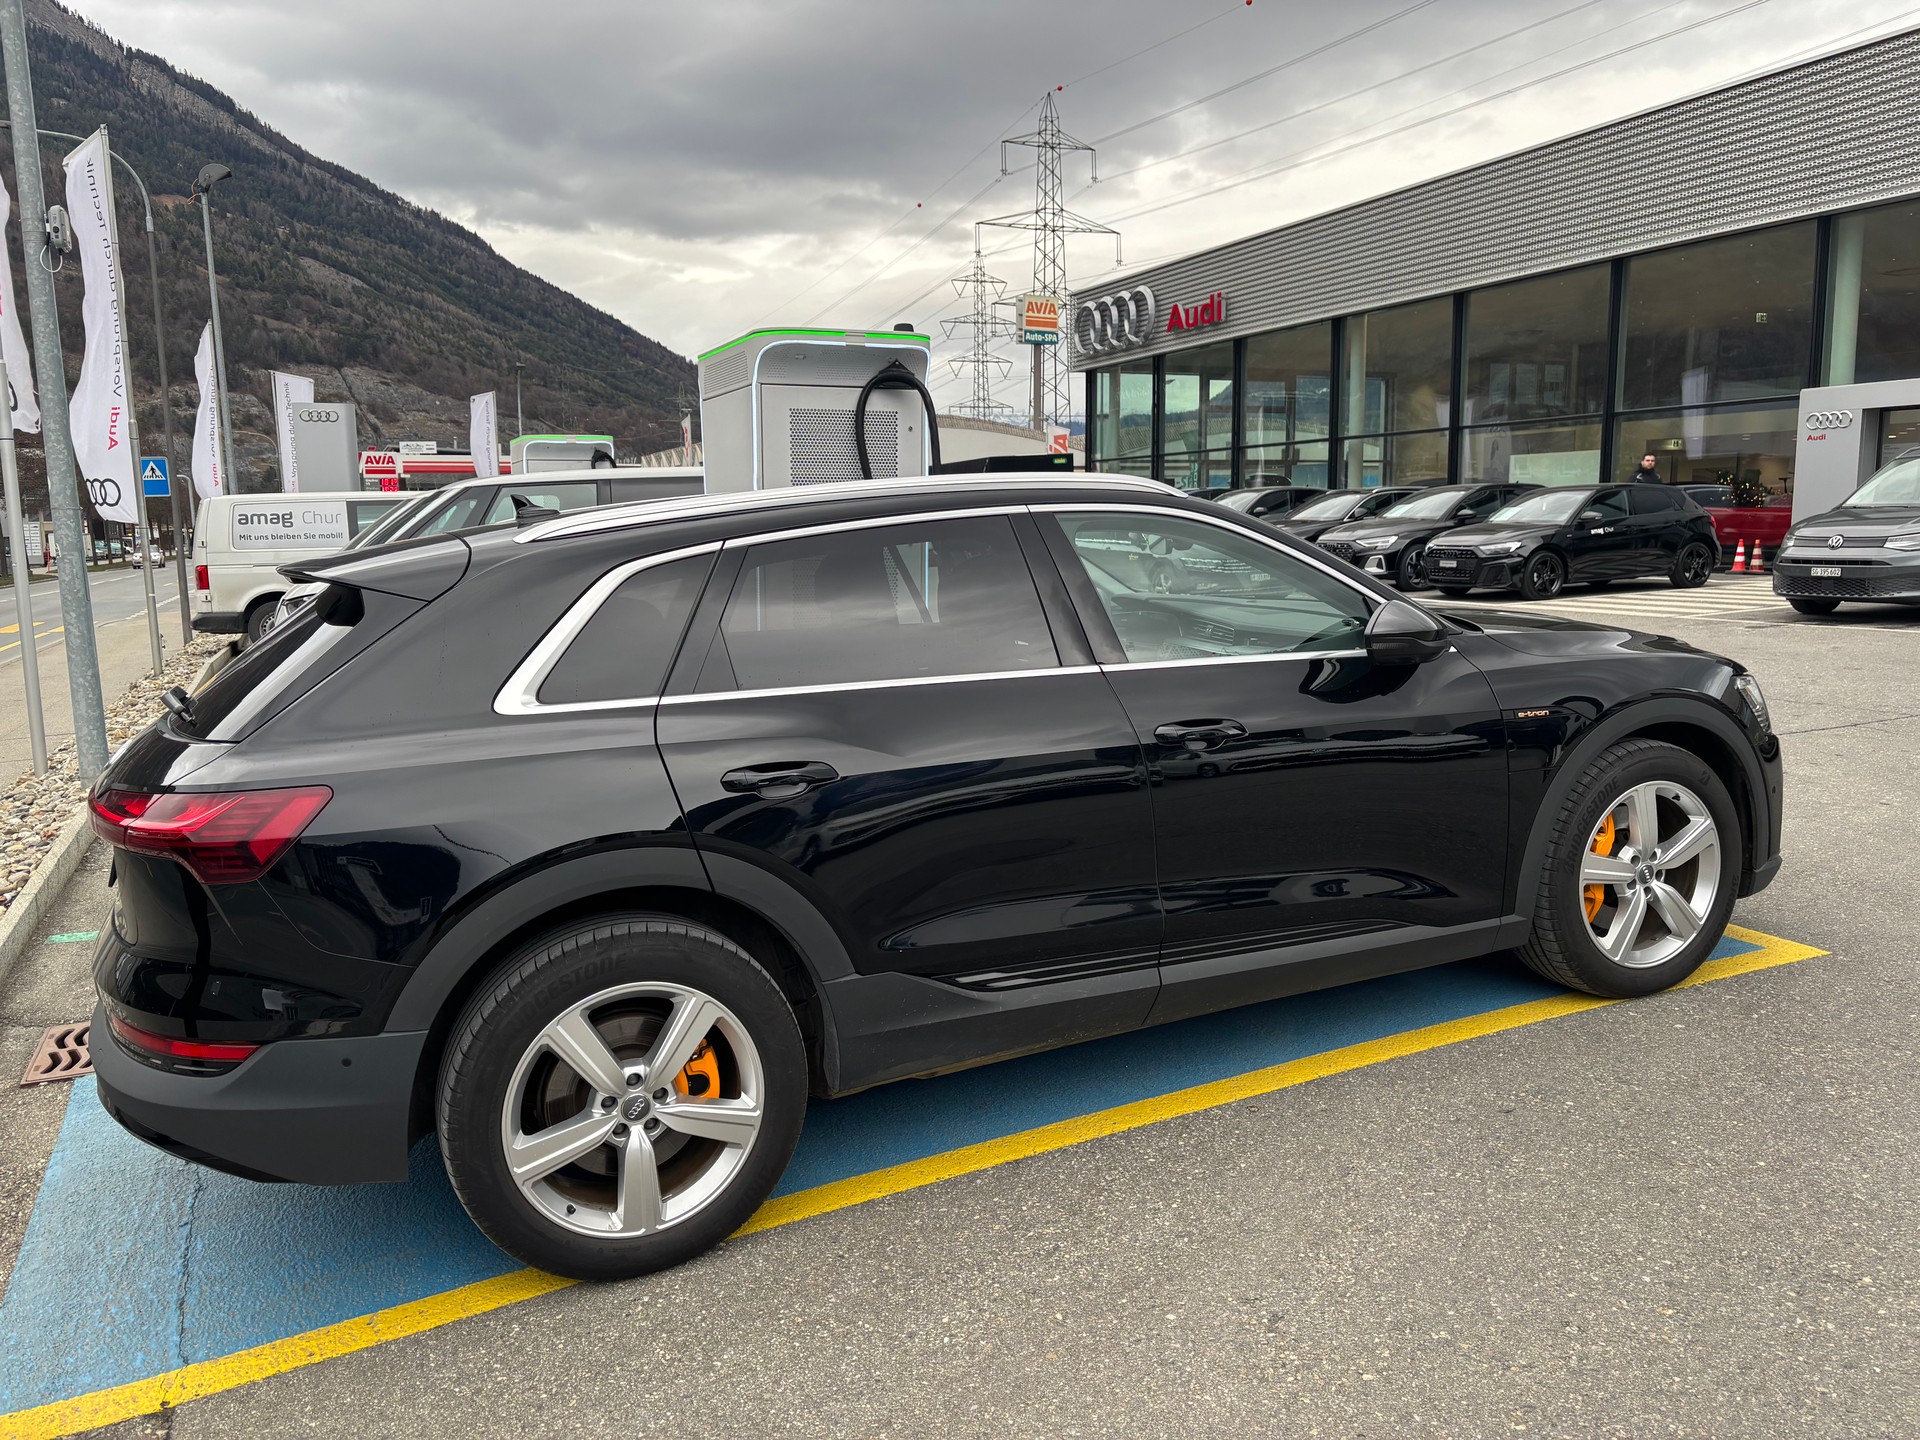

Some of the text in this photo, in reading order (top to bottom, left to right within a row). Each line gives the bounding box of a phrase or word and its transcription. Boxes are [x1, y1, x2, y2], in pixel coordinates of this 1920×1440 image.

[1166, 291, 1224, 333] Audi
[1025, 332, 1058, 342] Auto-SPA
[1806, 433, 1827, 441] Audi
[237, 510, 342, 528] amag Chur
[239, 533, 253, 541] Mit
[303, 532, 317, 540] Sie
[1518, 710, 1550, 718] e-tron
